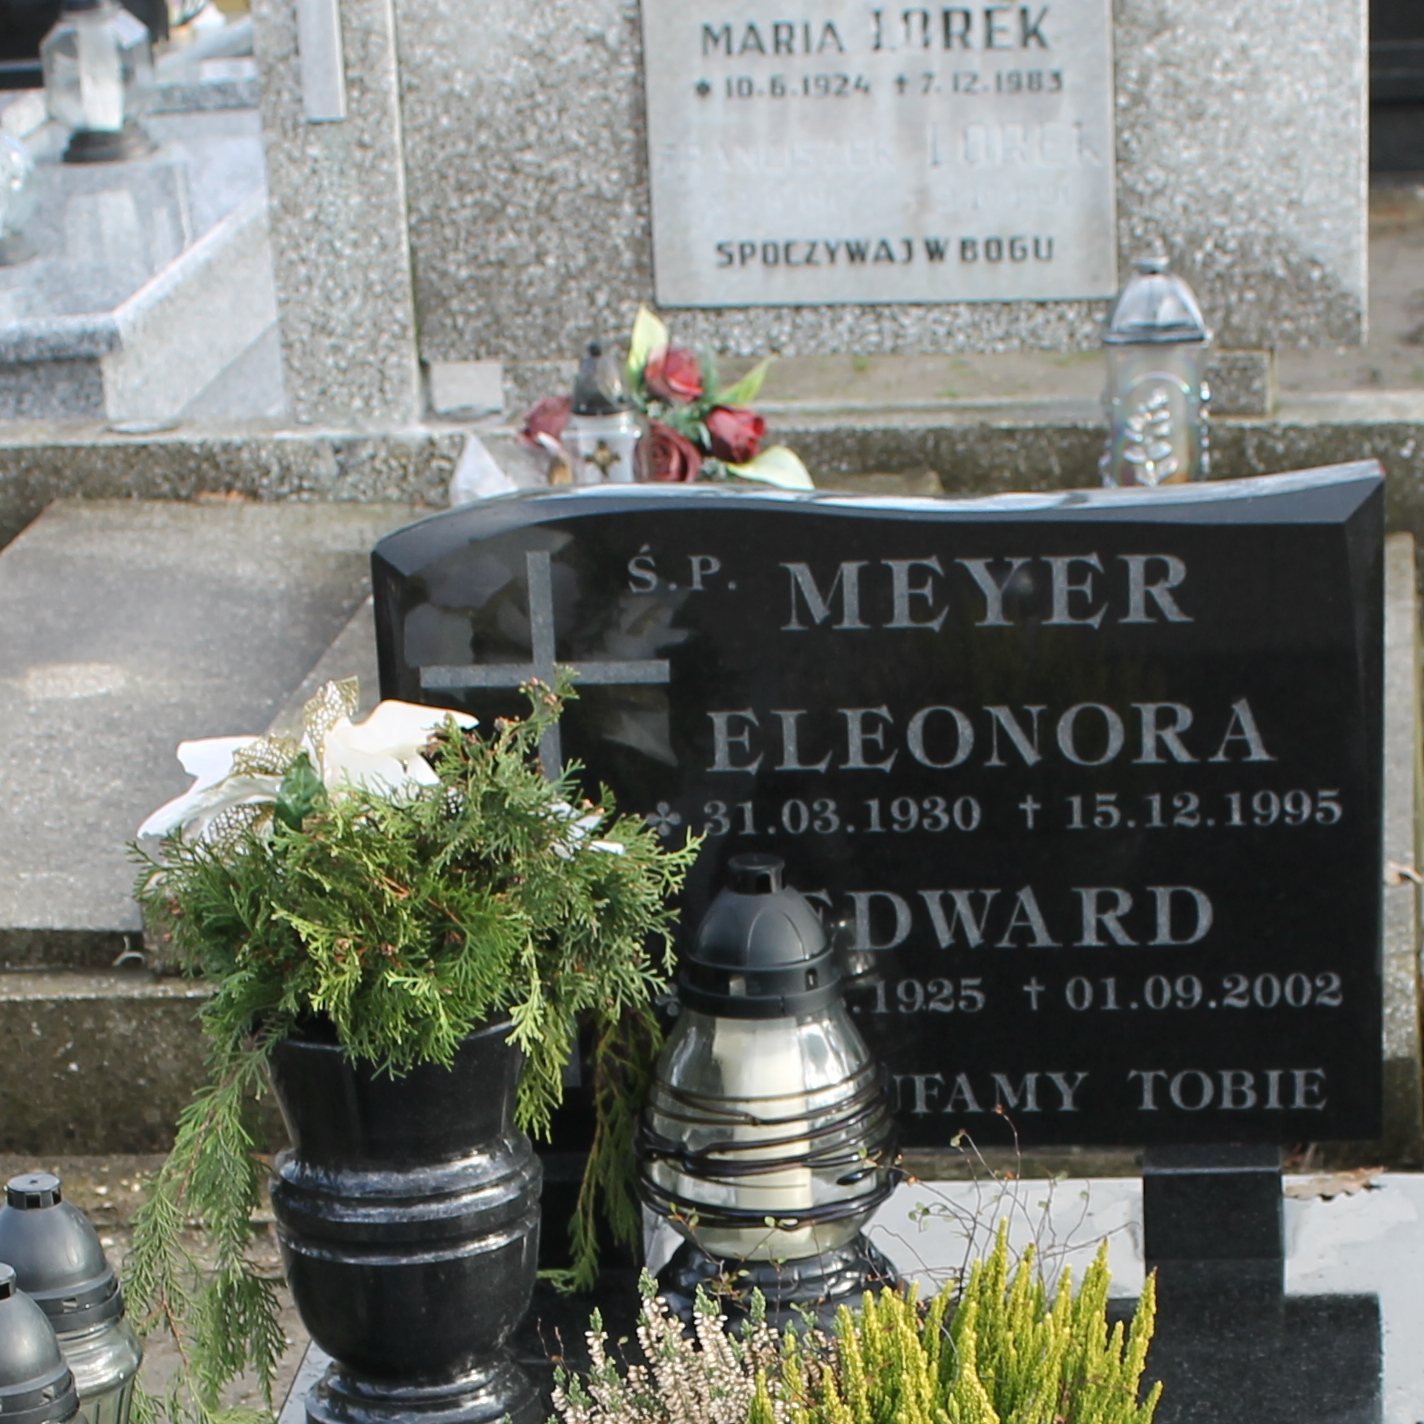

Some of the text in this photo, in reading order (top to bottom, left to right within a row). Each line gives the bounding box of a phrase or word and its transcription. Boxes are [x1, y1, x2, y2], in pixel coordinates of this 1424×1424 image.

[701, 5, 1051, 56] MARIA LOREK
[726, 73, 870, 98] 10.6.1924
[716, 236, 1055, 267] SPOCZYWAJ W BOGU
[626, 544, 1195, 631] Ś.P. MEYER
[705, 698, 1278, 775] ELEONORA
[703, 788, 1344, 836] 31.03.1930 15.12.1995
[799, 884, 1215, 953] DWARD
[841, 971, 1343, 1014] .1925 01.09.2002
[1127, 1066, 1328, 1112] TOBIE
